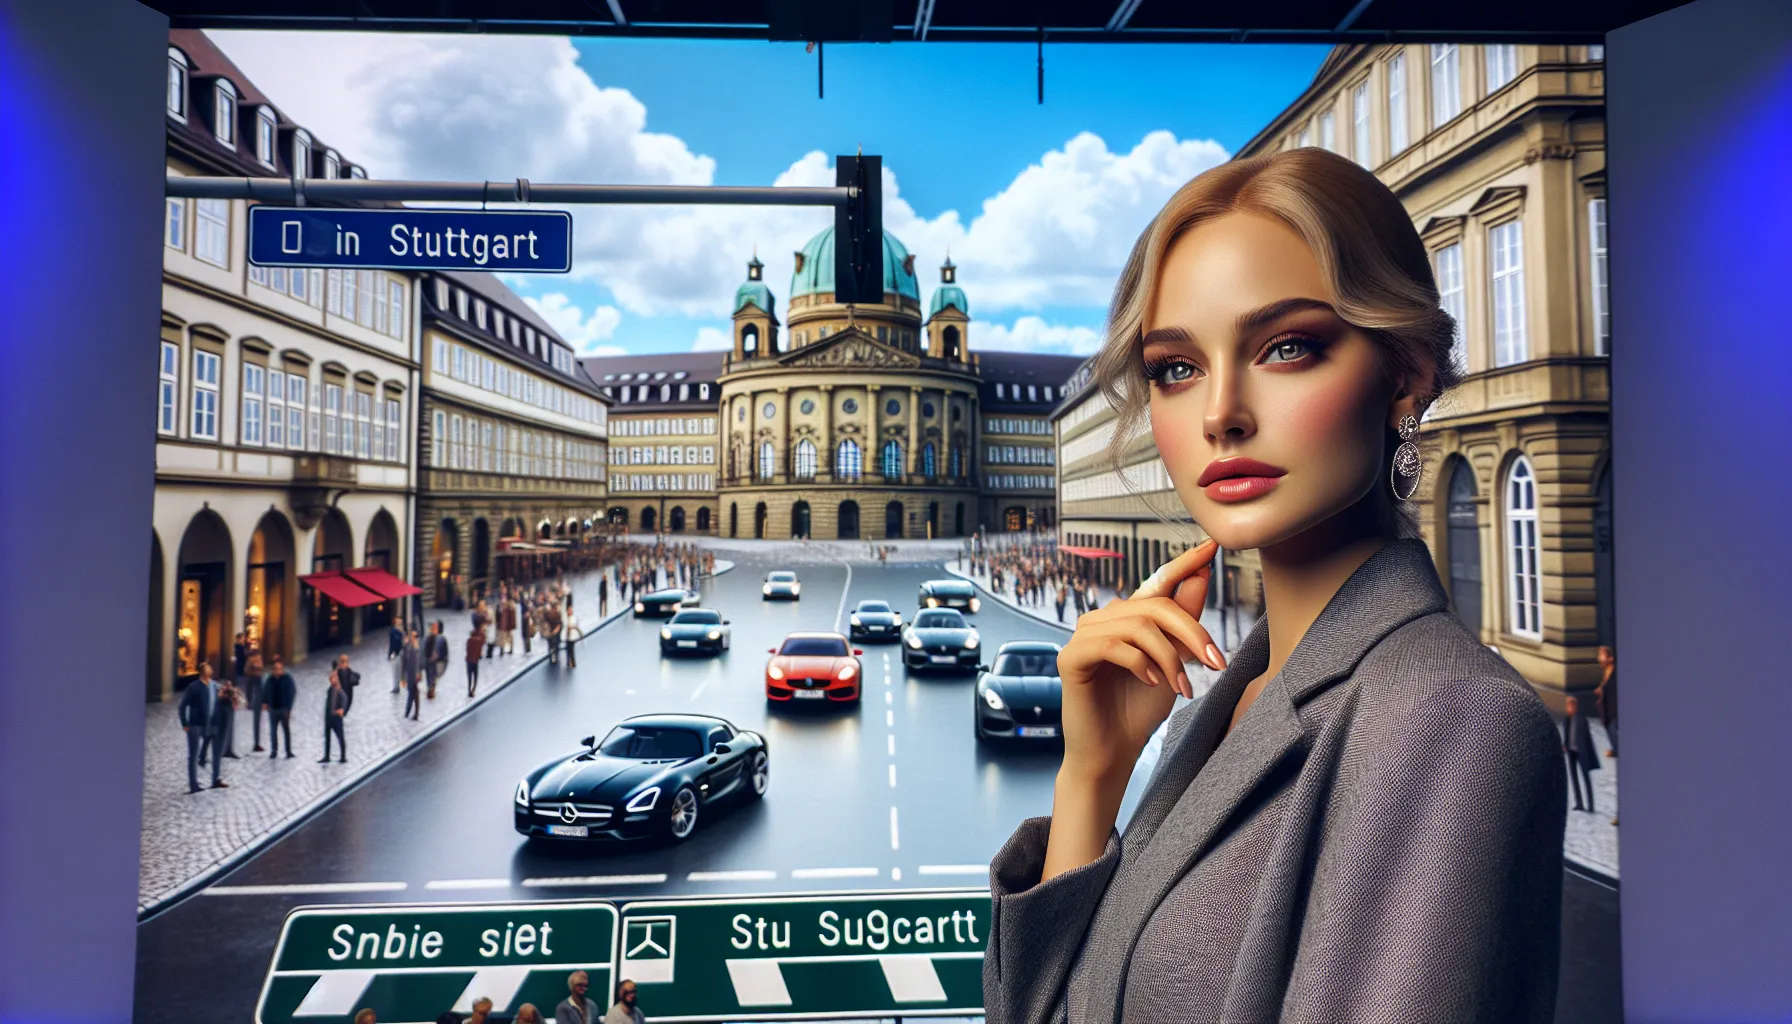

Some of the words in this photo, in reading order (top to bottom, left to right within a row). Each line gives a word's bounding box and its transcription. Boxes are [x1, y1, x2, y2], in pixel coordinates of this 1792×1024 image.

[336, 224, 360, 256] in
[389, 223, 540, 265] Stuttgart
[327, 923, 444, 961] Snbie
[478, 921, 554, 958] siet
[730, 913, 791, 950] Stu
